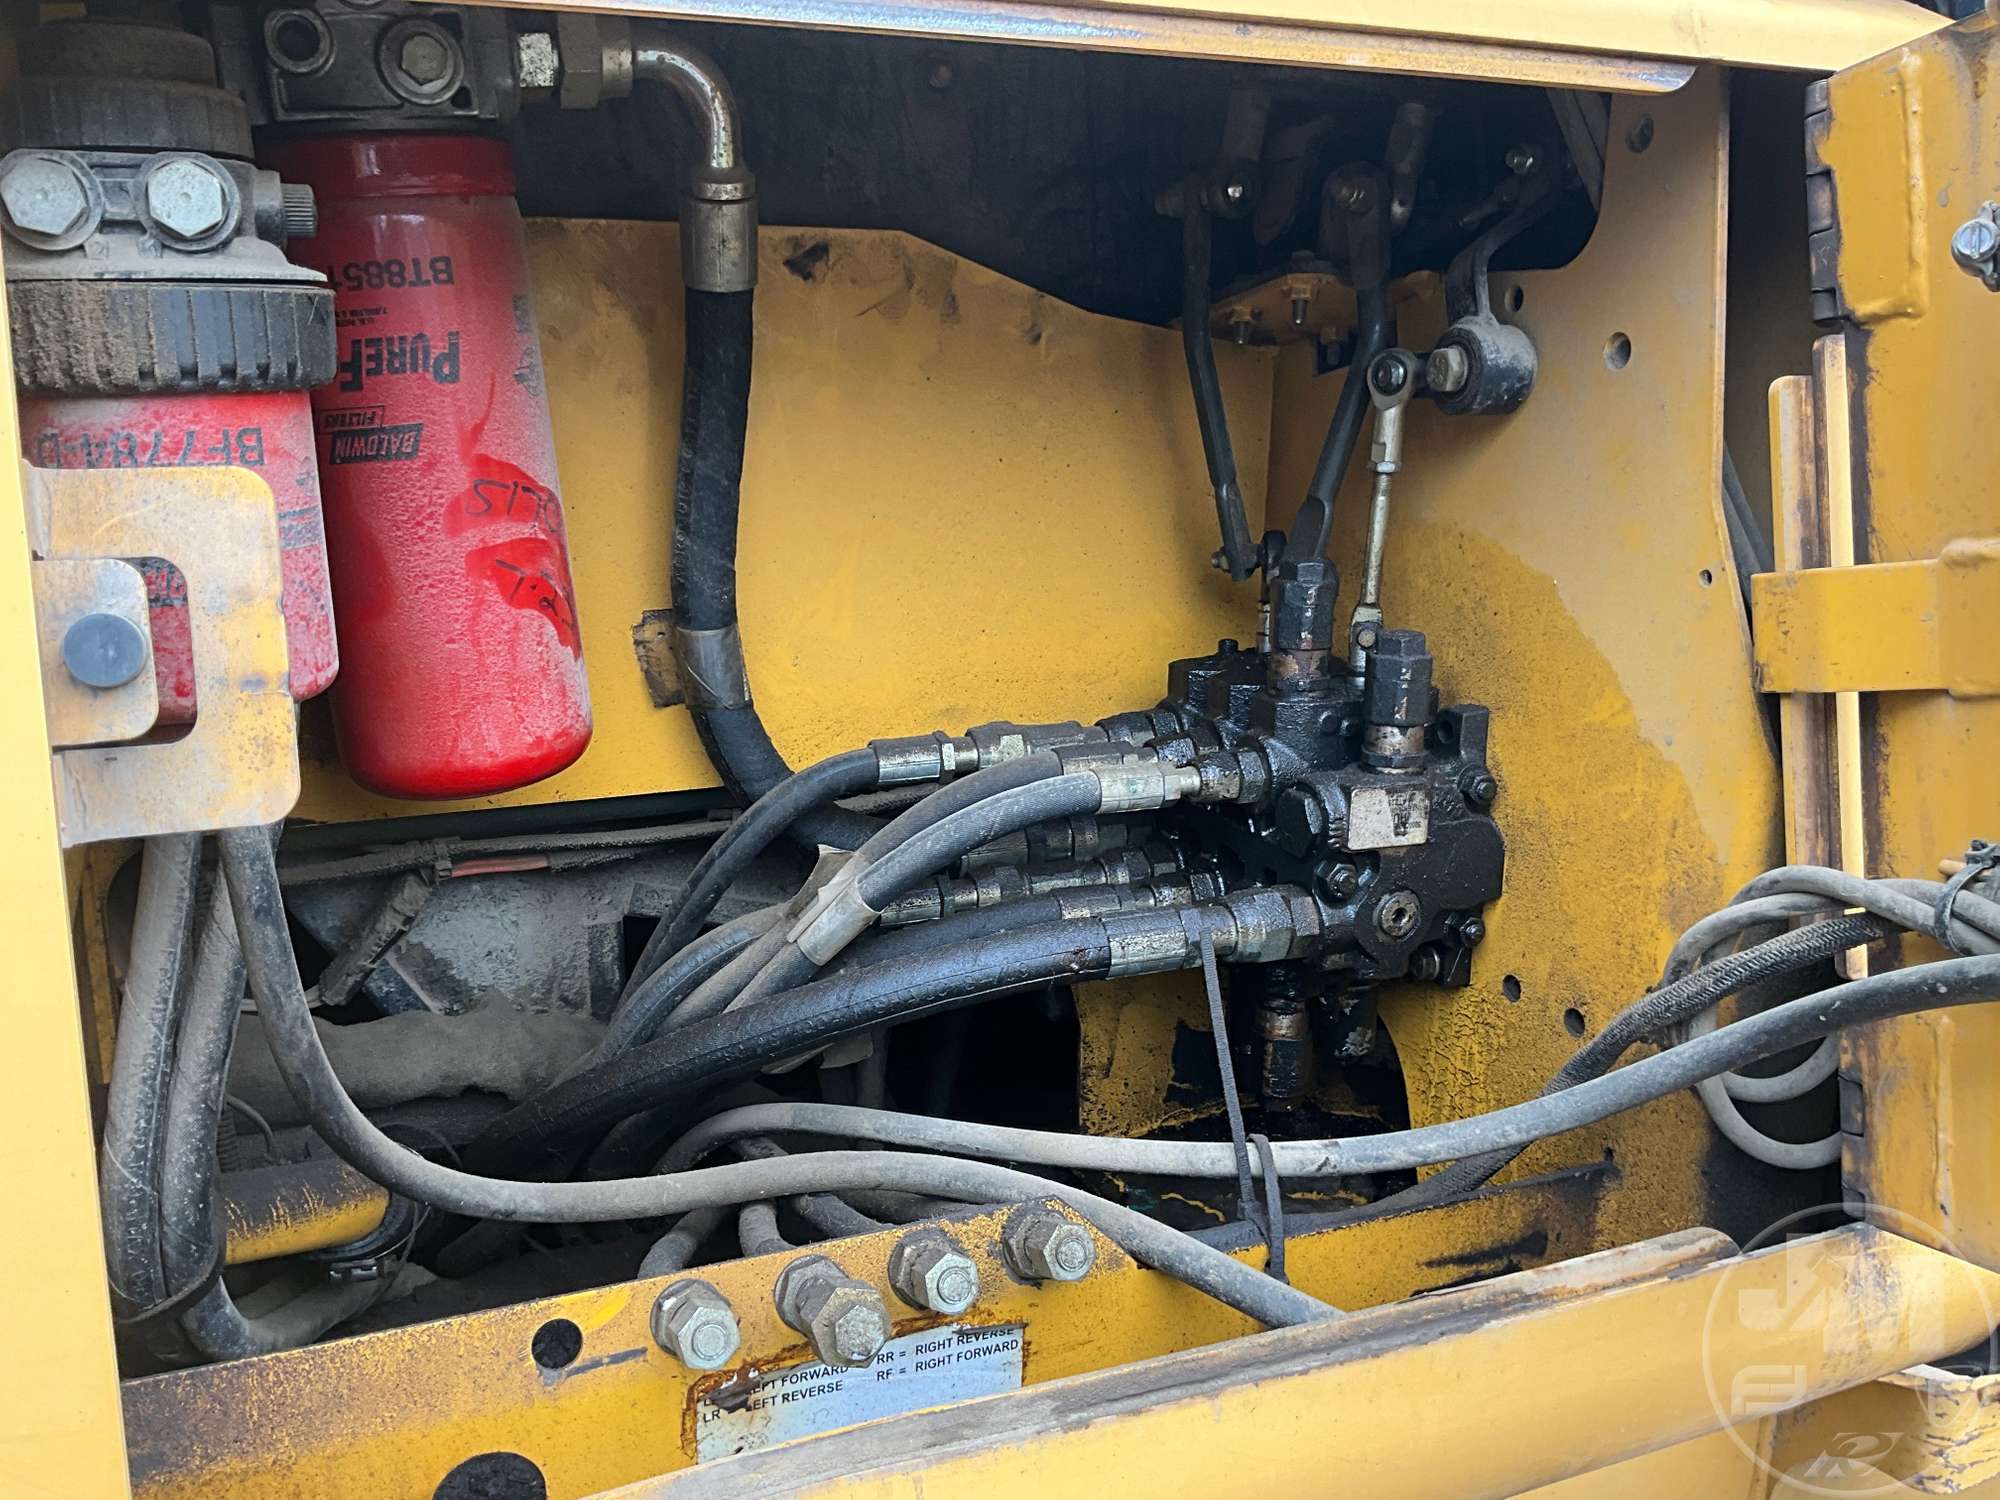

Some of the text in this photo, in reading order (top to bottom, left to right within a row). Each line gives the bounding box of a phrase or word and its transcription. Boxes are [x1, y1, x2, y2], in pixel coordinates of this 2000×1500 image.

[335, 431, 415, 459] BALDWIN
[877, 1351, 895, 1365] RR
[915, 1337, 954, 1356] RIGHT
[956, 1329, 1016, 1347] REVERSE
[877, 1367, 894, 1381] RF
[915, 1354, 954, 1373] RIGHT
[956, 1339, 1019, 1363] FORWARD
[781, 1366, 849, 1387] FORWARD
[703, 1409, 721, 1423] LR
[781, 1380, 844, 1405] REVERSE
